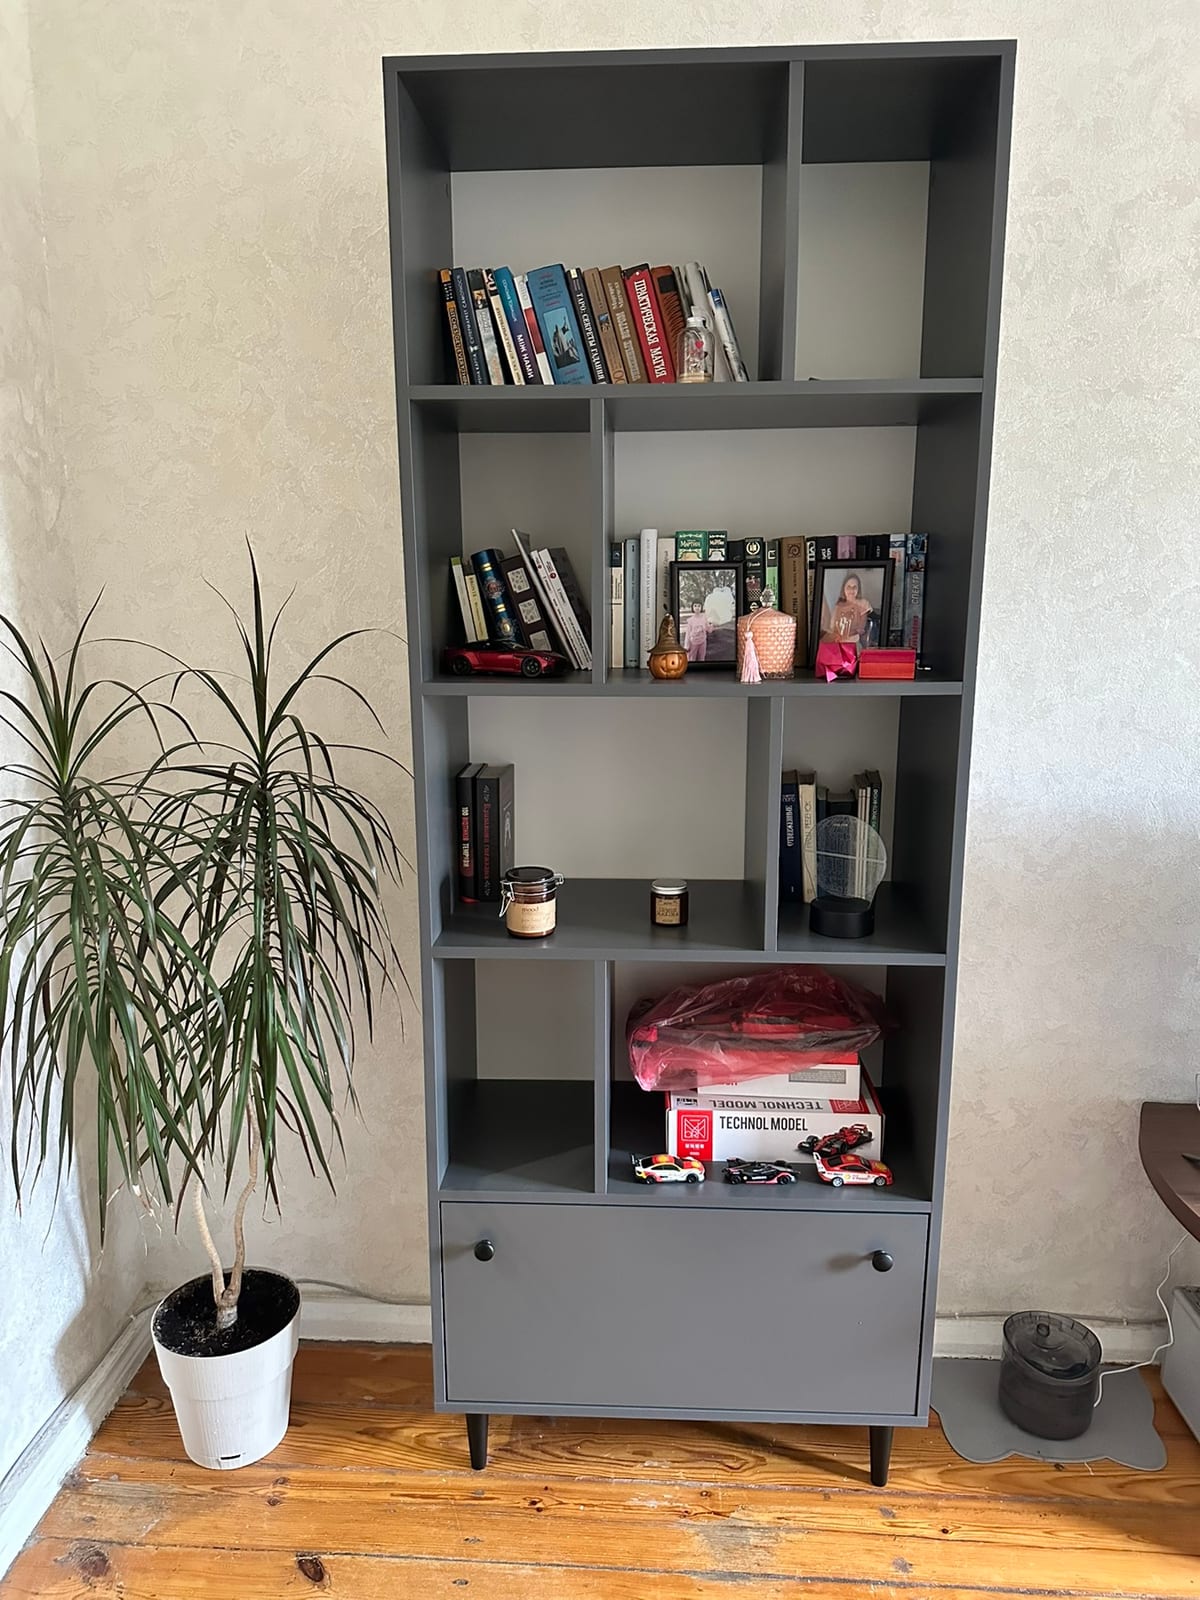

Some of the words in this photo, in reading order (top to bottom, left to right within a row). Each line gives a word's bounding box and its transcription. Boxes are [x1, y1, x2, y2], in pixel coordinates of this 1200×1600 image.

[576, 292, 587, 316] ТАРО:
[582, 314, 596, 348] СЕКРЕТЫ
[590, 345, 605, 381] ГАДАНИЯ
[634, 279, 659, 345] ПРАКТИЧЕСКАЯ
[650, 345, 666, 378] МАГИЯ
[455, 347, 470, 385] EVERYTHIN
[517, 334, 526, 356] МІЖ
[522, 354, 534, 379] НАМИ
[911, 573, 921, 605] СПЕКТР
[709, 1099, 758, 1109] MODEL
[760, 1100, 824, 1111] TECHNOL
[719, 1115, 770, 1132] TECHNOL
[770, 1116, 809, 1132] MODEL
